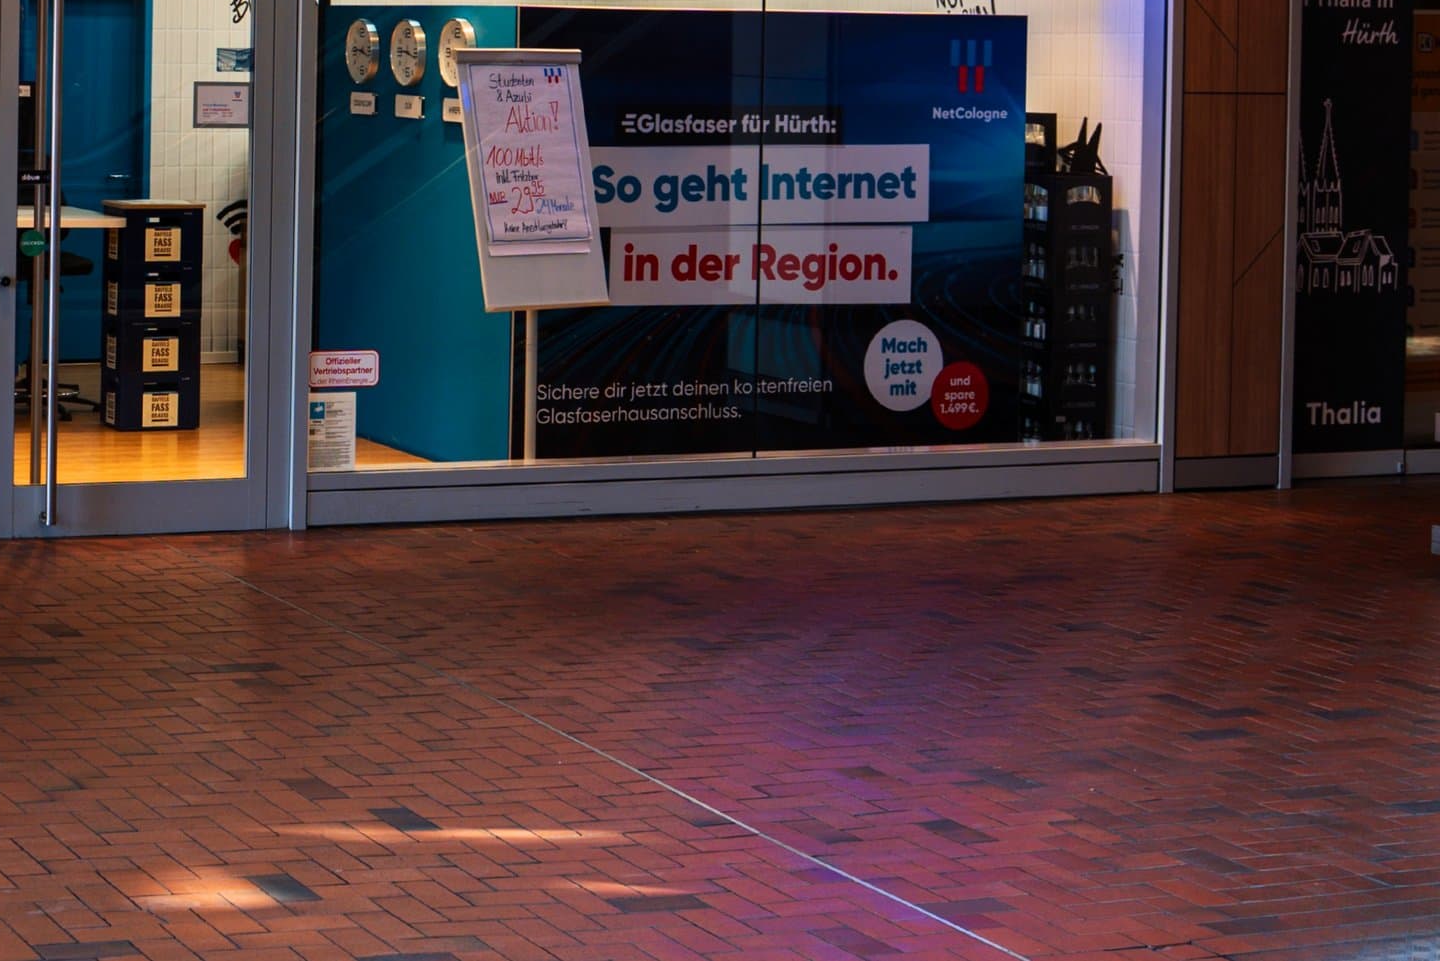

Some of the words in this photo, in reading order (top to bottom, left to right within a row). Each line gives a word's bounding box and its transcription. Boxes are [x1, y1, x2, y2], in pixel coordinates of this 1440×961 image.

[1341, 17, 1400, 45] Hürth
[506, 89, 532, 103] Azubi
[505, 100, 559, 134] Aktion!
[742, 113, 769, 133] für
[775, 113, 837, 133] Hürth:
[932, 106, 1008, 123] NetCologne
[486, 144, 513, 168] 100
[592, 165, 642, 203] So
[653, 165, 748, 213] geht
[760, 164, 917, 201] Internet
[154, 238, 172, 247] FASS
[623, 243, 658, 282] in
[671, 244, 740, 282] der
[751, 243, 898, 292] Region.
[154, 293, 172, 302] FASS
[152, 348, 170, 357] FASS
[881, 337, 928, 353] Mach
[313, 367, 373, 376] Vertriebspartner
[884, 358, 922, 380] jetzt
[890, 379, 917, 396] mit
[950, 375, 971, 386] und
[537, 383, 600, 400] Sichere
[604, 382, 625, 398] dir
[629, 382, 668, 402] jetzt
[672, 380, 729, 396] deinen
[944, 391, 976, 402] spare
[152, 403, 170, 412] FASS
[537, 403, 743, 425] Glasfaserhausanschluss.
[1306, 400, 1382, 425] Thalia
